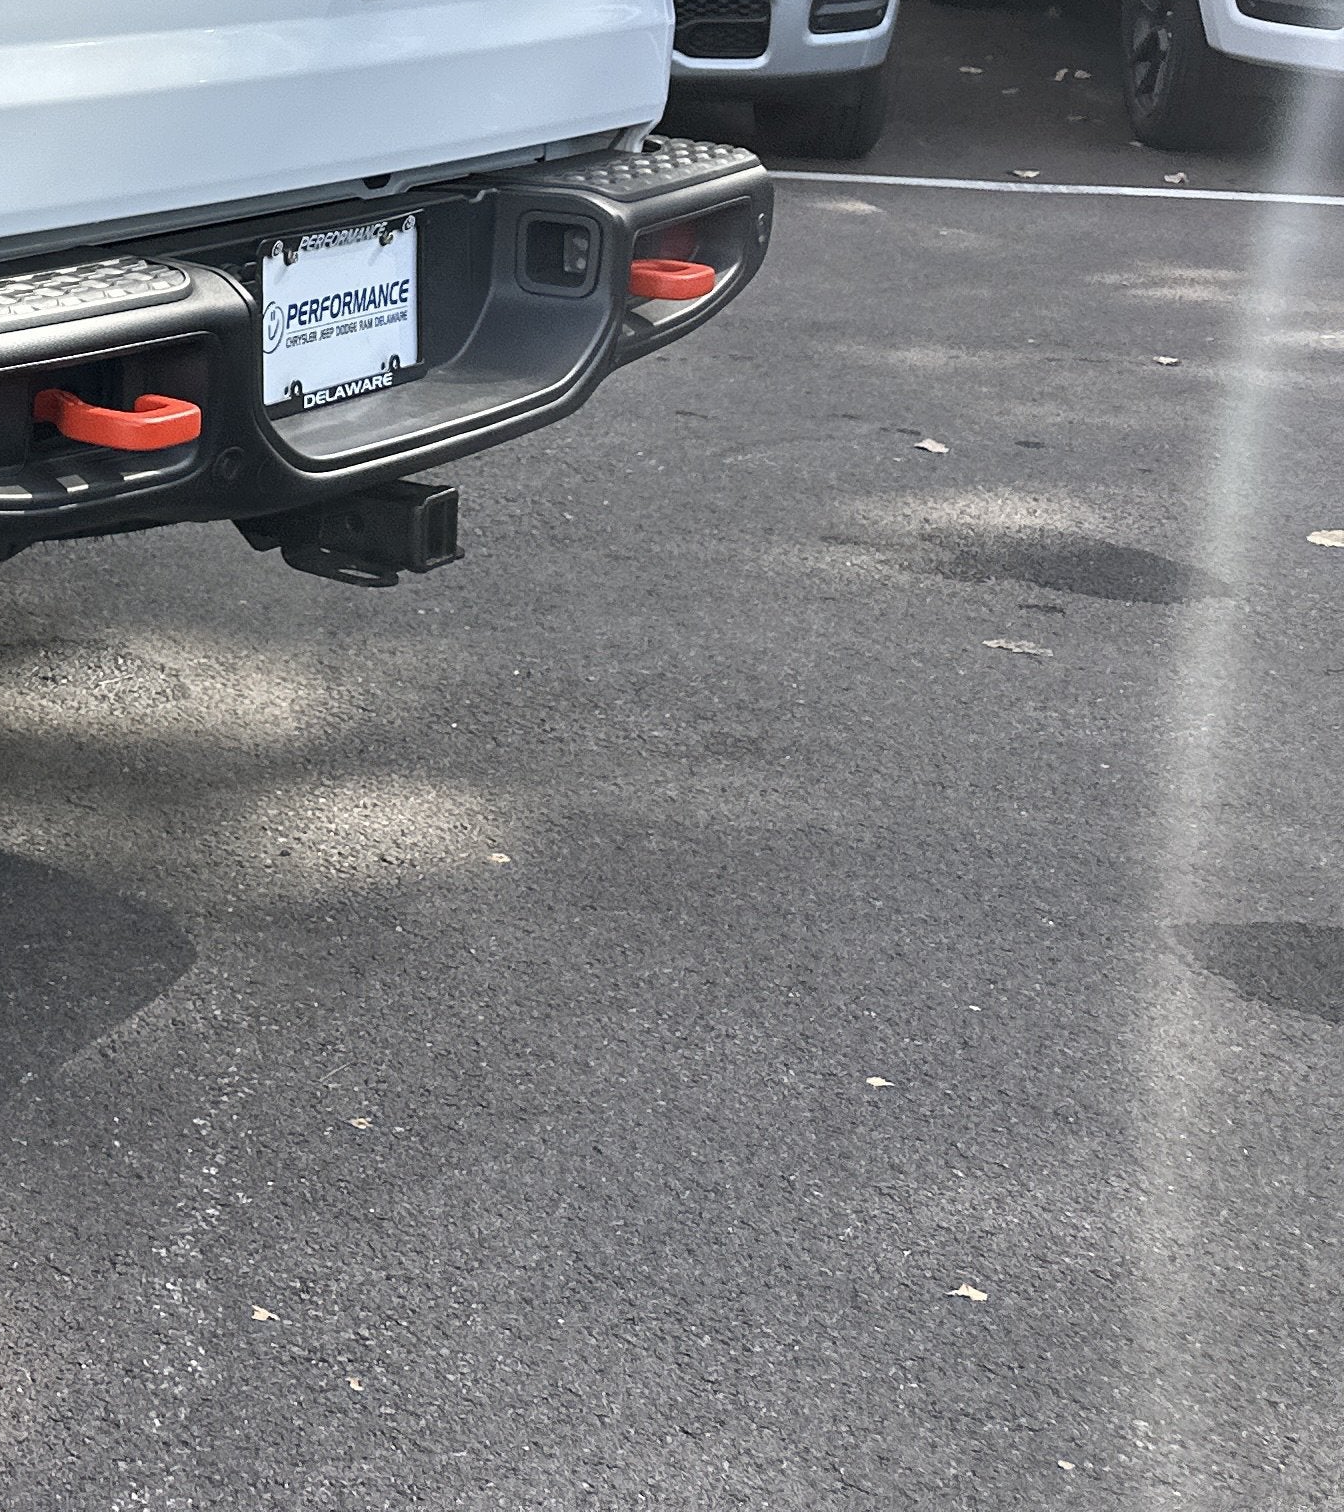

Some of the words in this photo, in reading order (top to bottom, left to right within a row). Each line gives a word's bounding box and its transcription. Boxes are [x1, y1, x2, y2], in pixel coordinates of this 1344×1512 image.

[298, 221, 389, 252] PERFORMANCE
[286, 278, 410, 330] PERFORMANCE
[285, 330, 318, 349] CHRYSLER
[318, 326, 335, 341] JEEP
[335, 320, 359, 337] DODGE
[358, 317, 374, 333] RAM
[374, 309, 408, 328] DELAWARE
[302, 371, 394, 409] DELAWARE
